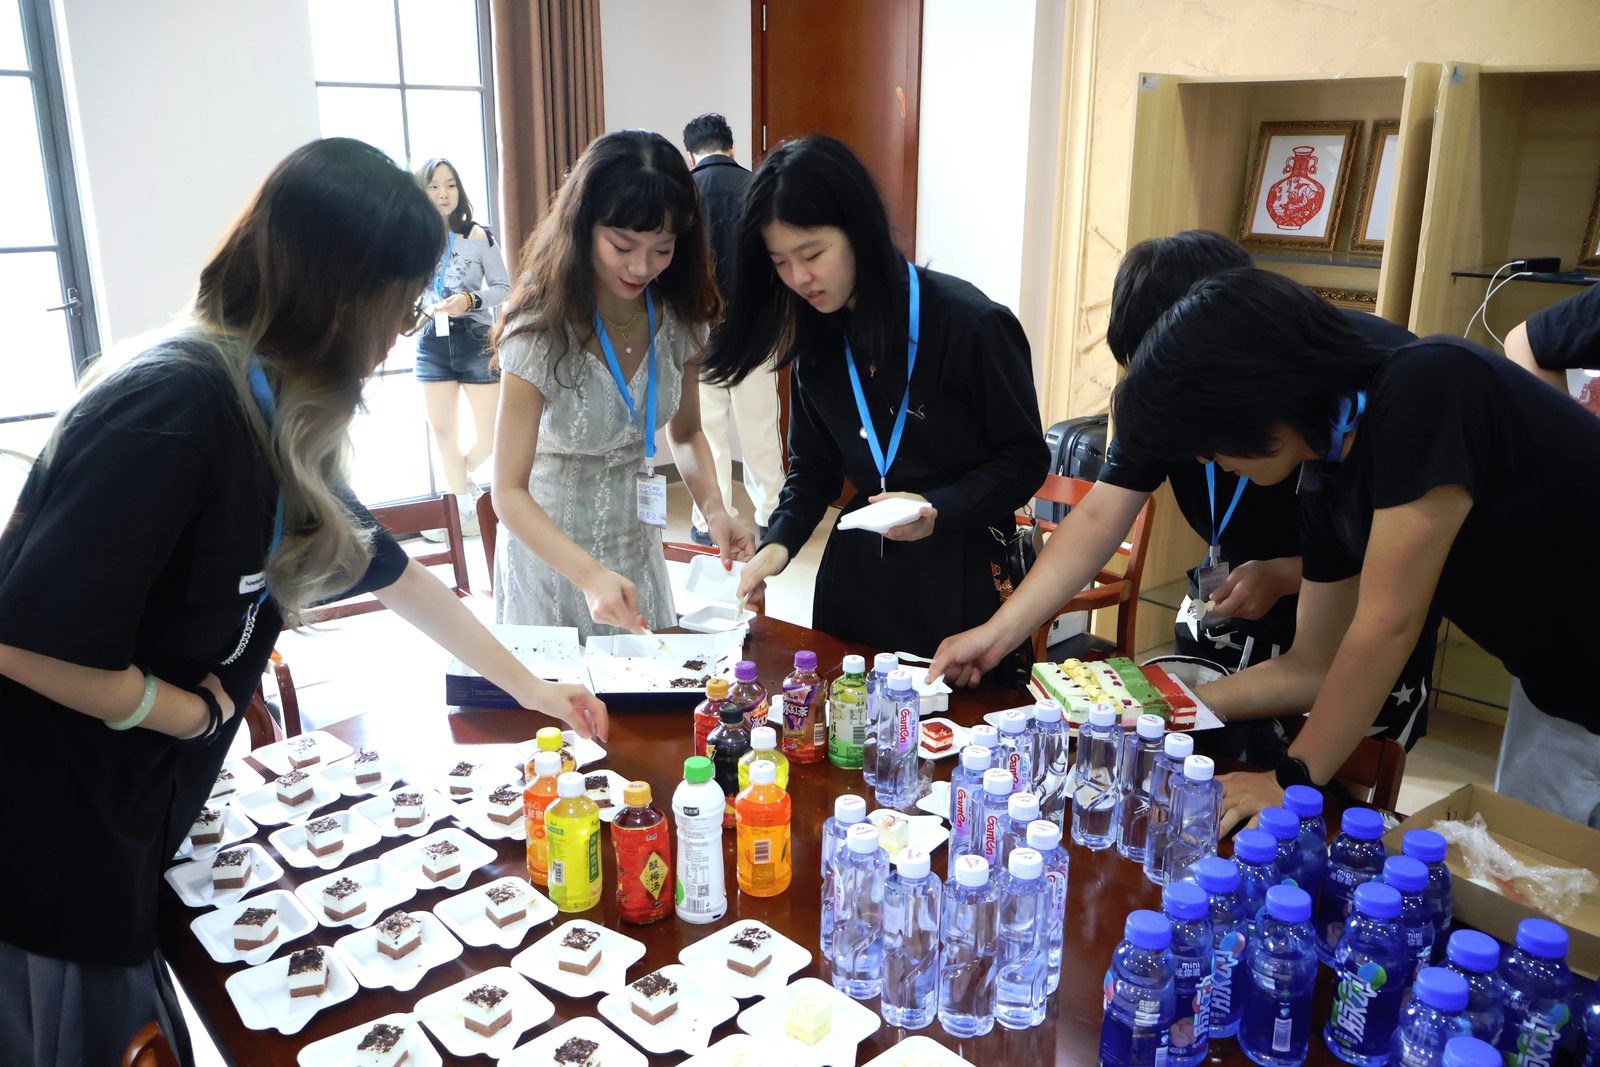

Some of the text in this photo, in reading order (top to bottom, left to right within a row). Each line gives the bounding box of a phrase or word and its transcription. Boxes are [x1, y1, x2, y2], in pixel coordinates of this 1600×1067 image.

[649, 859, 660, 892] 酸梅汤
[1336, 970, 1378, 1043] 脉动
